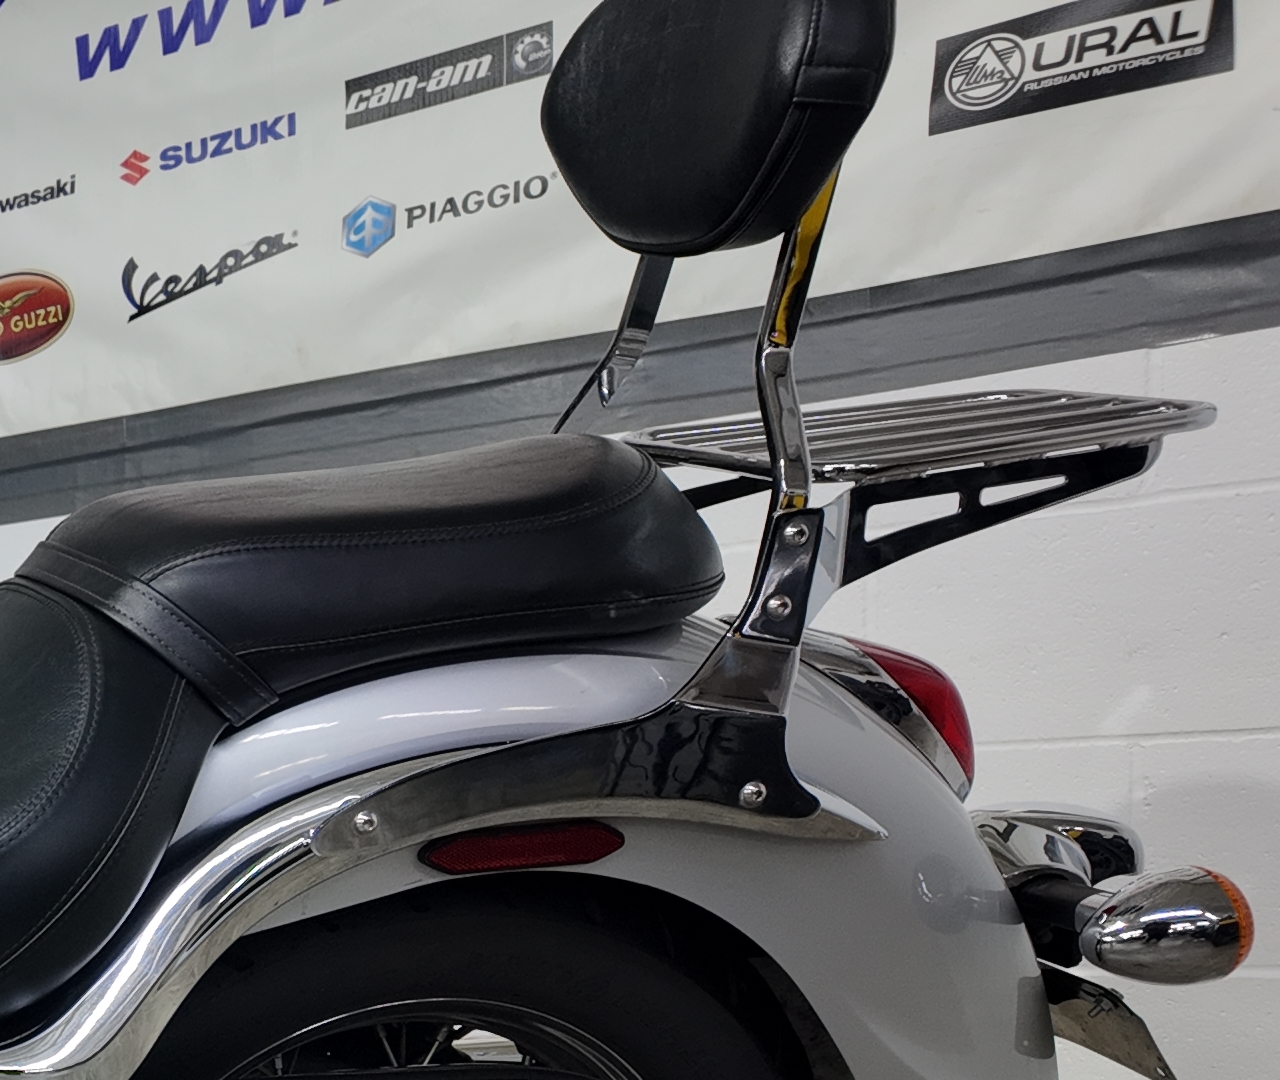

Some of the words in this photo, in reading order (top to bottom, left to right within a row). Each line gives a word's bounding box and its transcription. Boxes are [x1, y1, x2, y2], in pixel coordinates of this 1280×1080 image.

[1023, 70, 1090, 92] RUSSIAN
[1092, 45, 1207, 77] MOTORCYCLES
[1032, 10, 1200, 72] URAL
[346, 53, 492, 115] can-am
[159, 112, 296, 171] SUZUKI
[405, 175, 549, 229] PIAGGIO
[121, 232, 298, 324] Vespa
[10, 305, 63, 333] GUZZI
